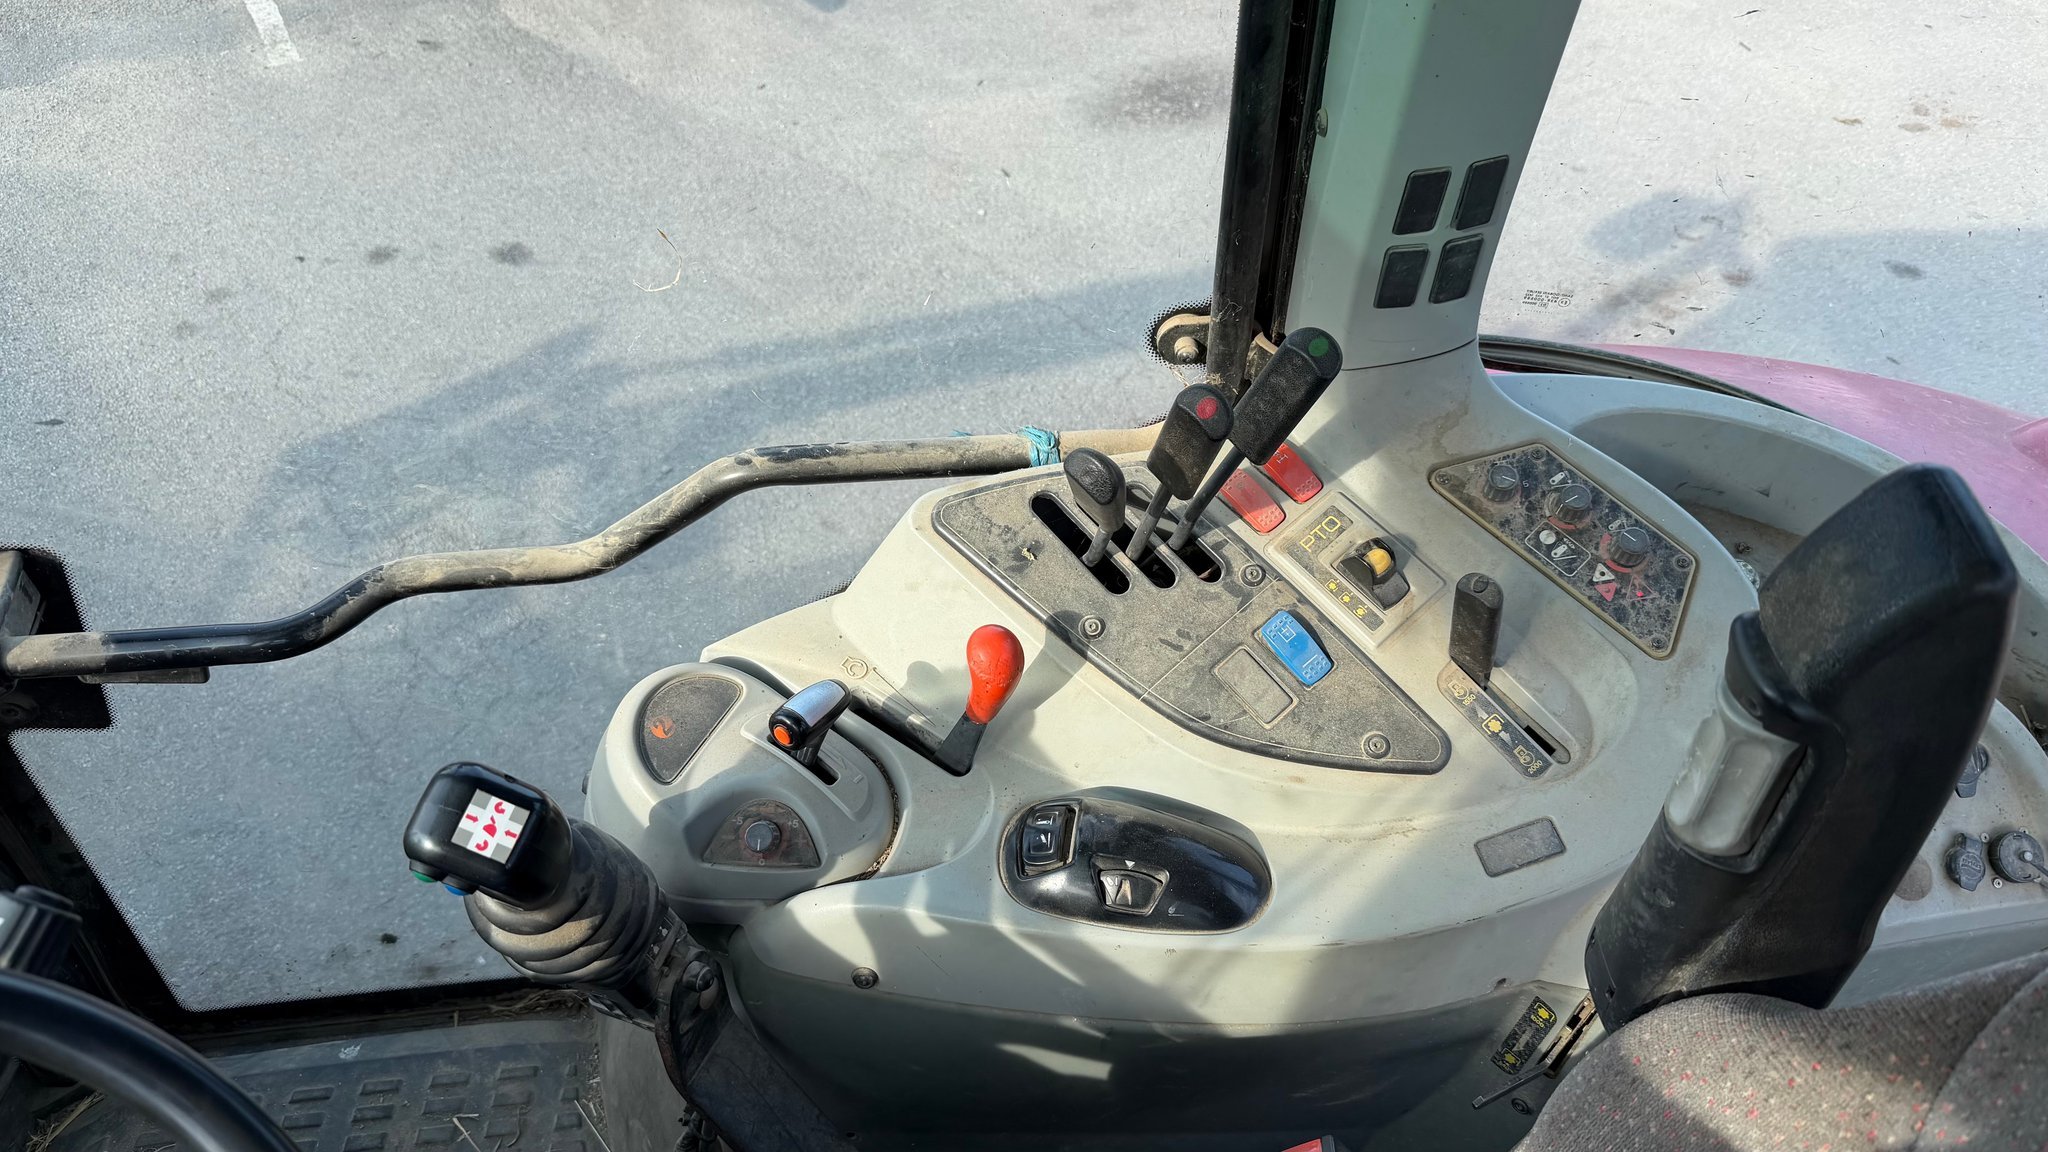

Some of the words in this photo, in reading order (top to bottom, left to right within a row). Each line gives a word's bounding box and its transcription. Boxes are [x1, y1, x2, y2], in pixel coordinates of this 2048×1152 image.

[1299, 515, 1341, 552] PTO
[1528, 760, 1542, 774] 2000
[1530, 1014, 1545, 1028] 1000
